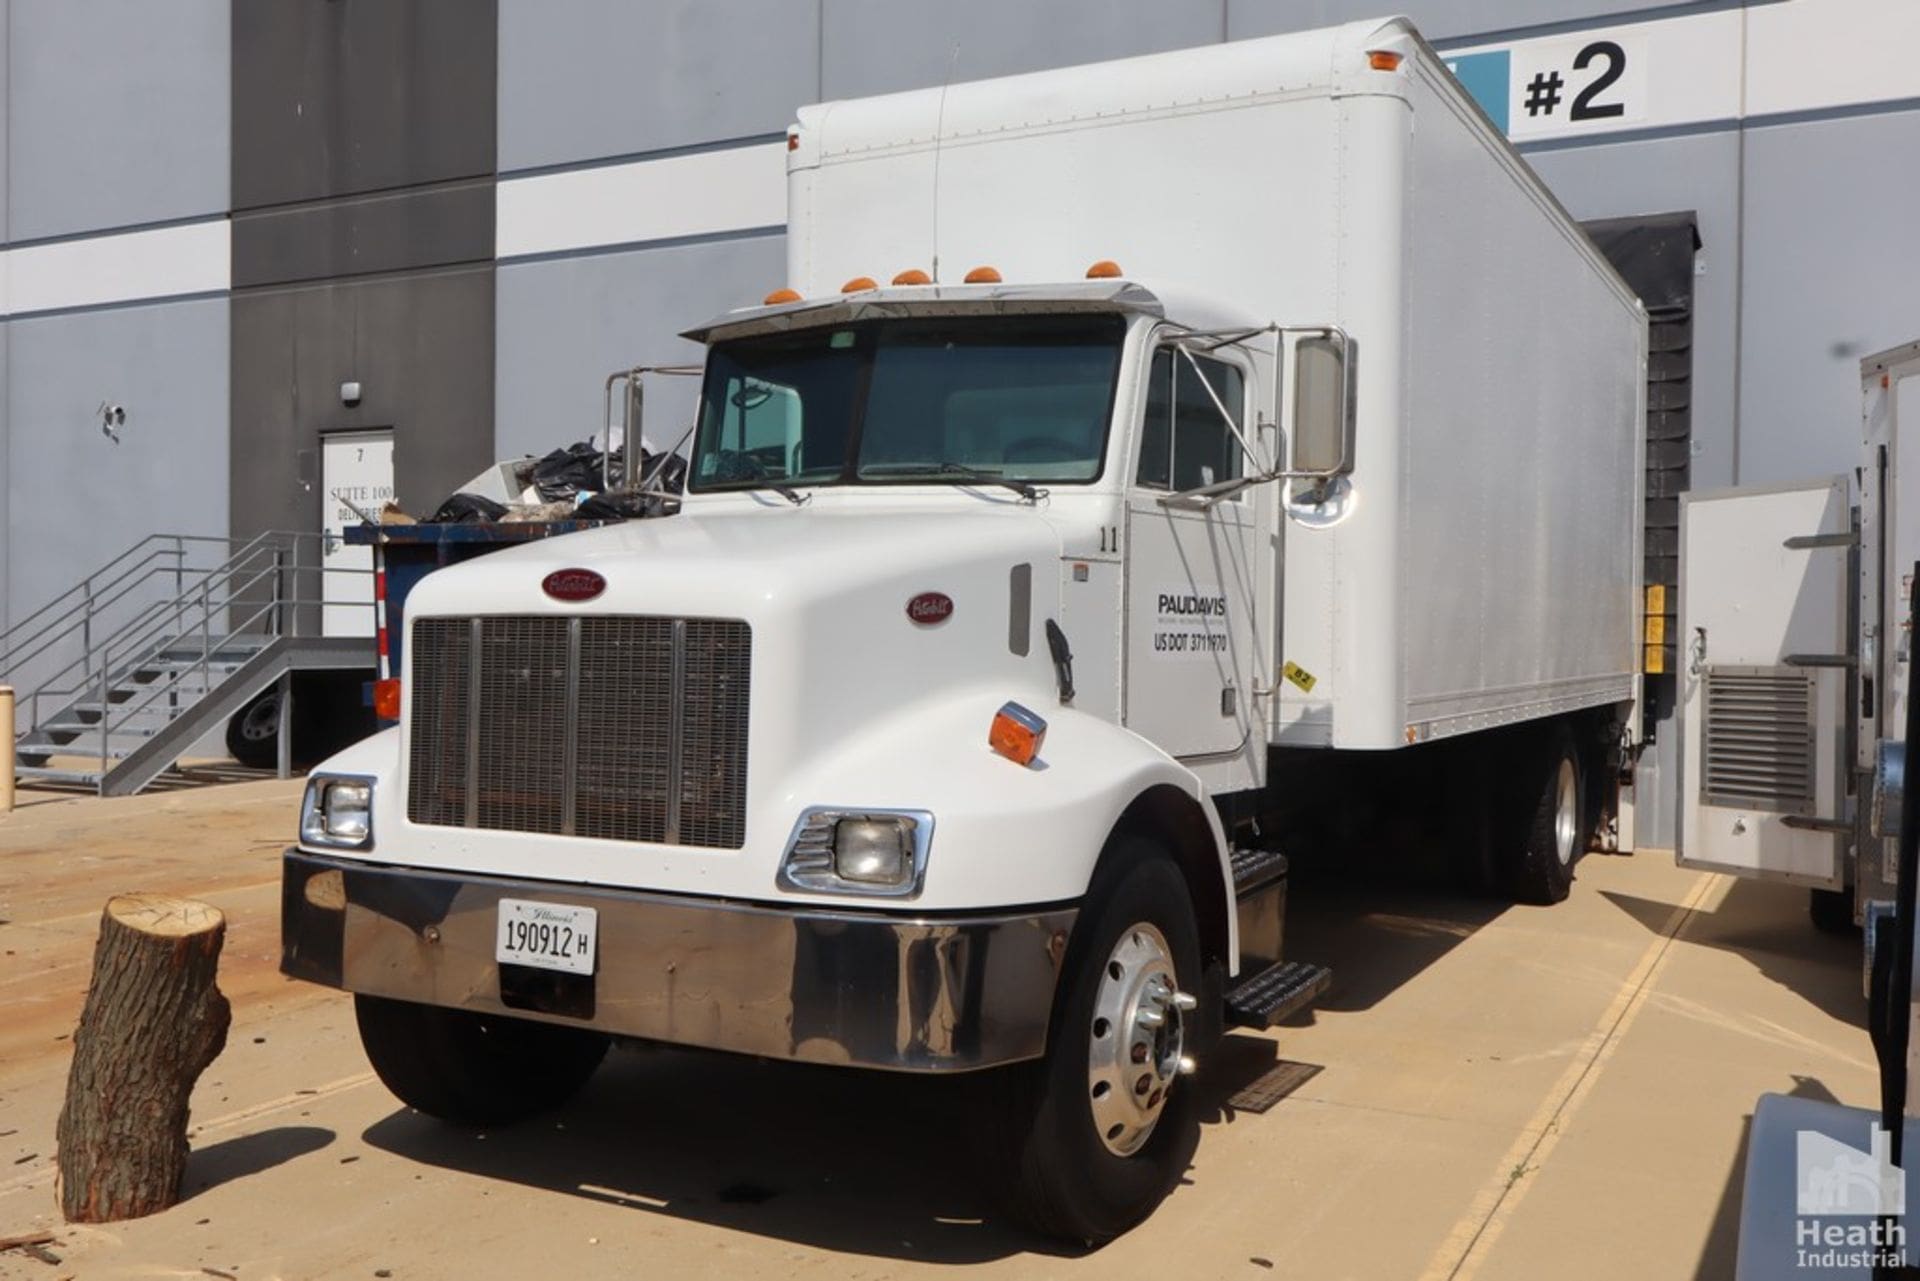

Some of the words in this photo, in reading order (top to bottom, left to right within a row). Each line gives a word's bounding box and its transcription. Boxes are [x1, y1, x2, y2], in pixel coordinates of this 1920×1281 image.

[1524, 41, 1627, 122] #2
[357, 448, 364, 462] 7
[330, 486, 369, 501] SUITE
[1100, 526, 1117, 552] 11
[1154, 633, 1167, 652] US
[1169, 633, 1188, 652] DOT
[505, 920, 573, 958] 190912
[577, 933, 588, 955] H
